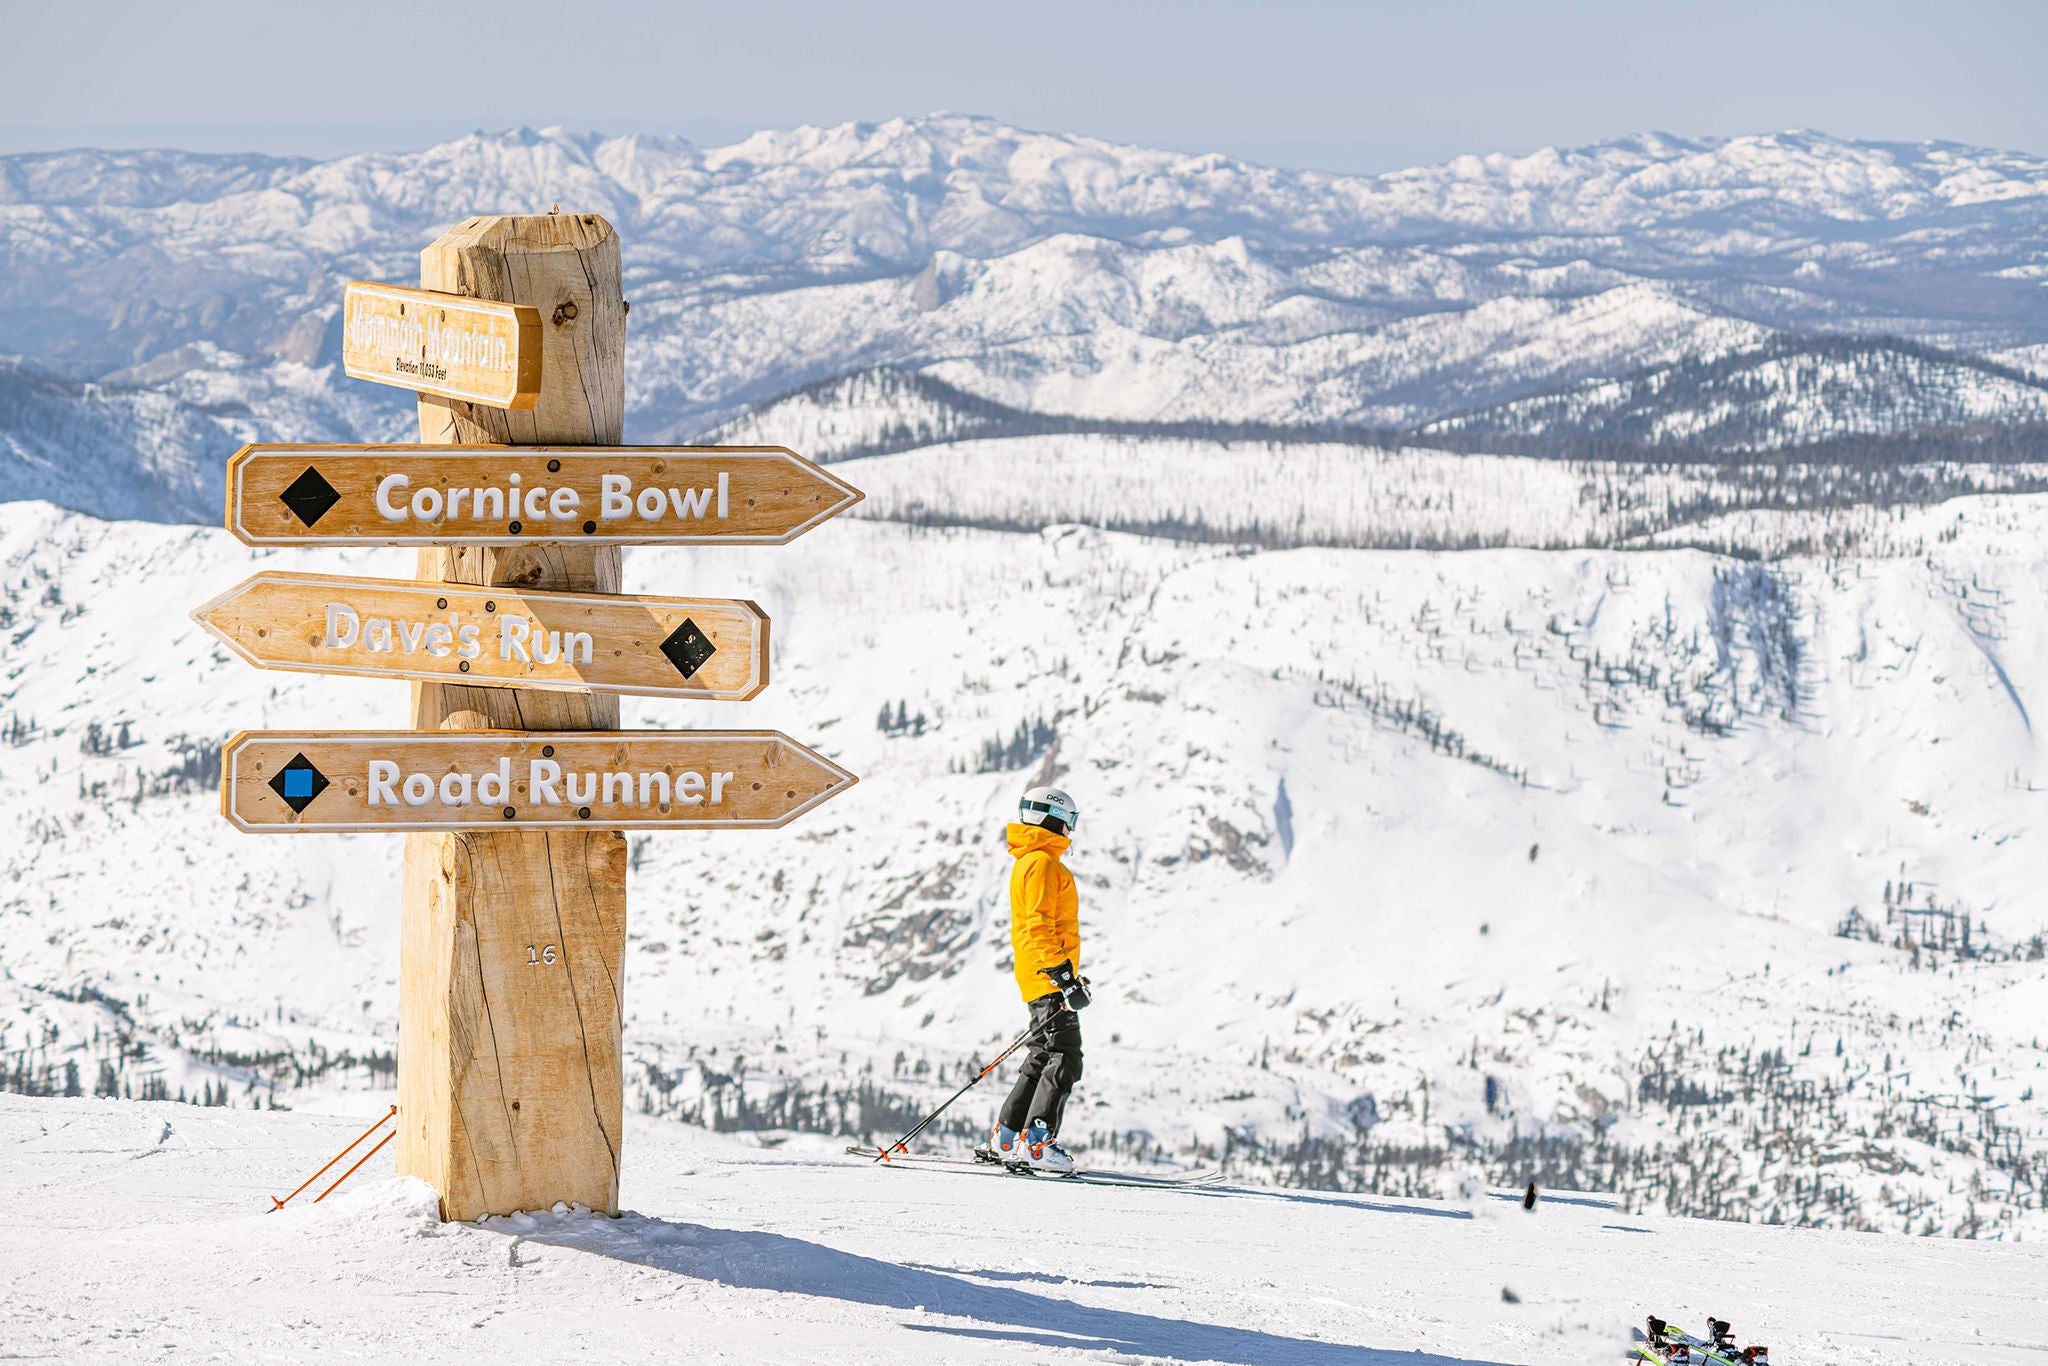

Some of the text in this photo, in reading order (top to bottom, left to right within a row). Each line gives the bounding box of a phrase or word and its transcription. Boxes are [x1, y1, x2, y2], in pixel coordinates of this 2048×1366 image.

[349, 299, 506, 370] Mammoth Mountain
[396, 357, 418, 374] Elevation
[435, 366, 447, 381] Feet
[380, 472, 728, 520] Cornice Bowl
[325, 603, 593, 664] Dave's Run
[368, 757, 734, 805] Road Runner
[526, 944, 556, 966] 16
